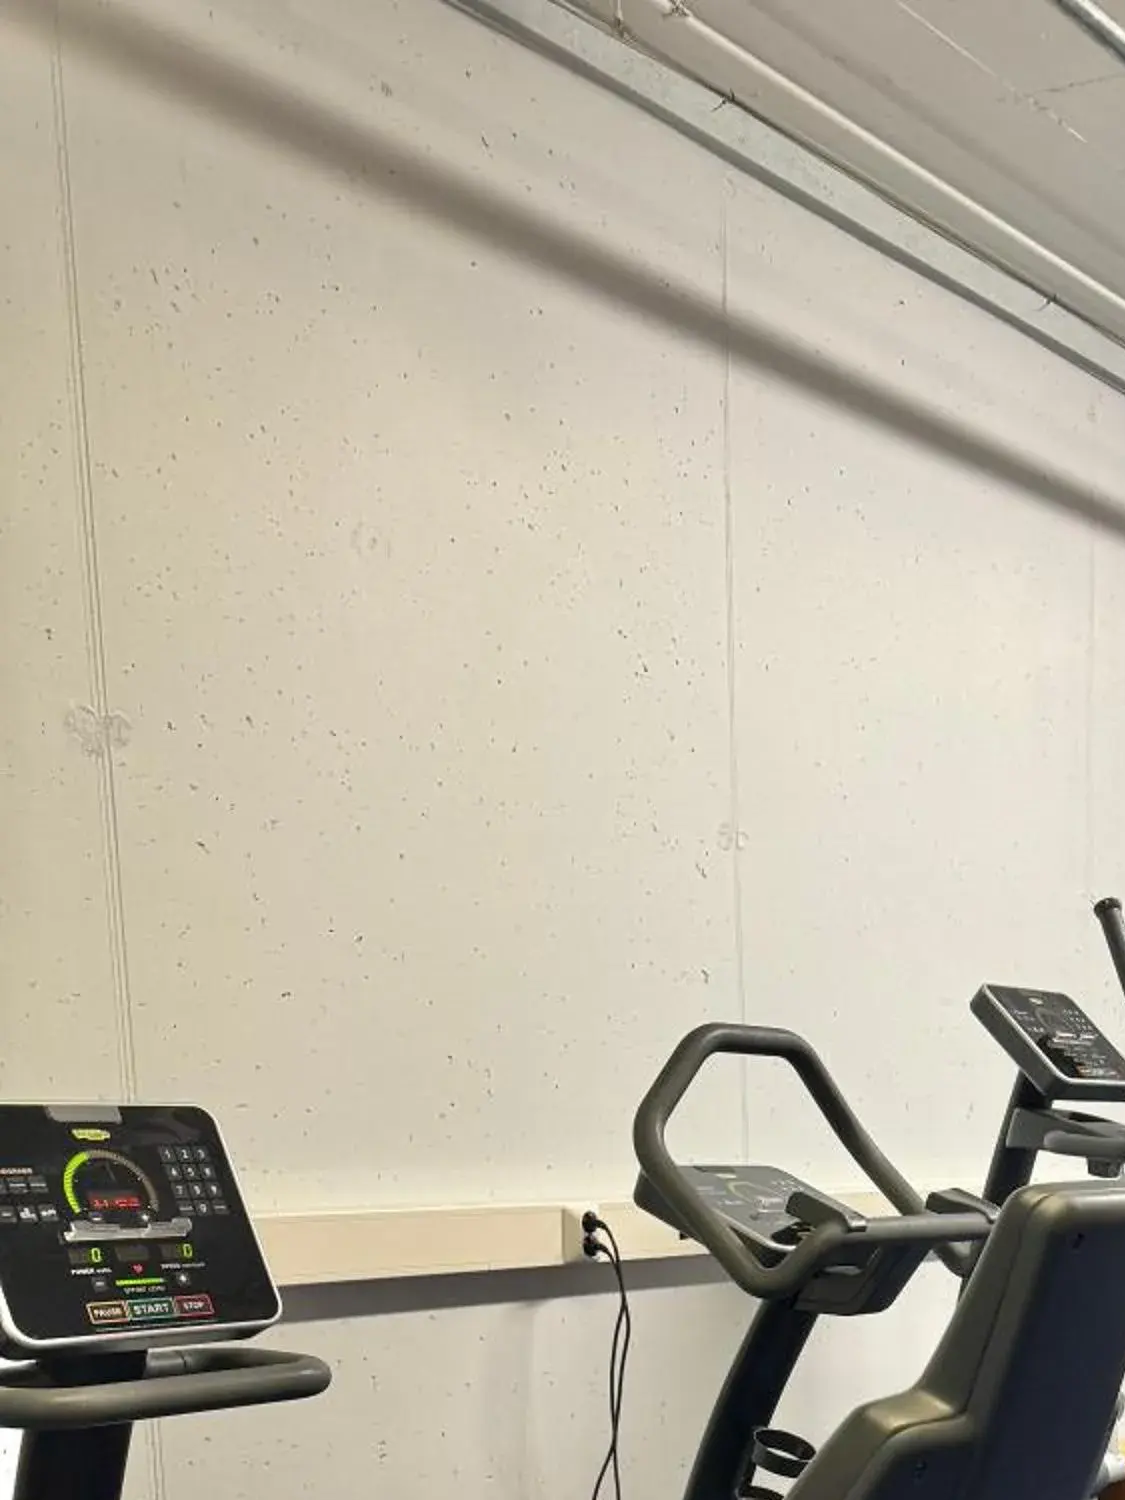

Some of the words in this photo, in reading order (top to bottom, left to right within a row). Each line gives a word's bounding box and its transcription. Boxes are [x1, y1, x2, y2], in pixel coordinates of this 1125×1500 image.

[91, 1247, 102, 1263] 0
[182, 1243, 193, 1258] 0
[132, 1302, 169, 1316] START
